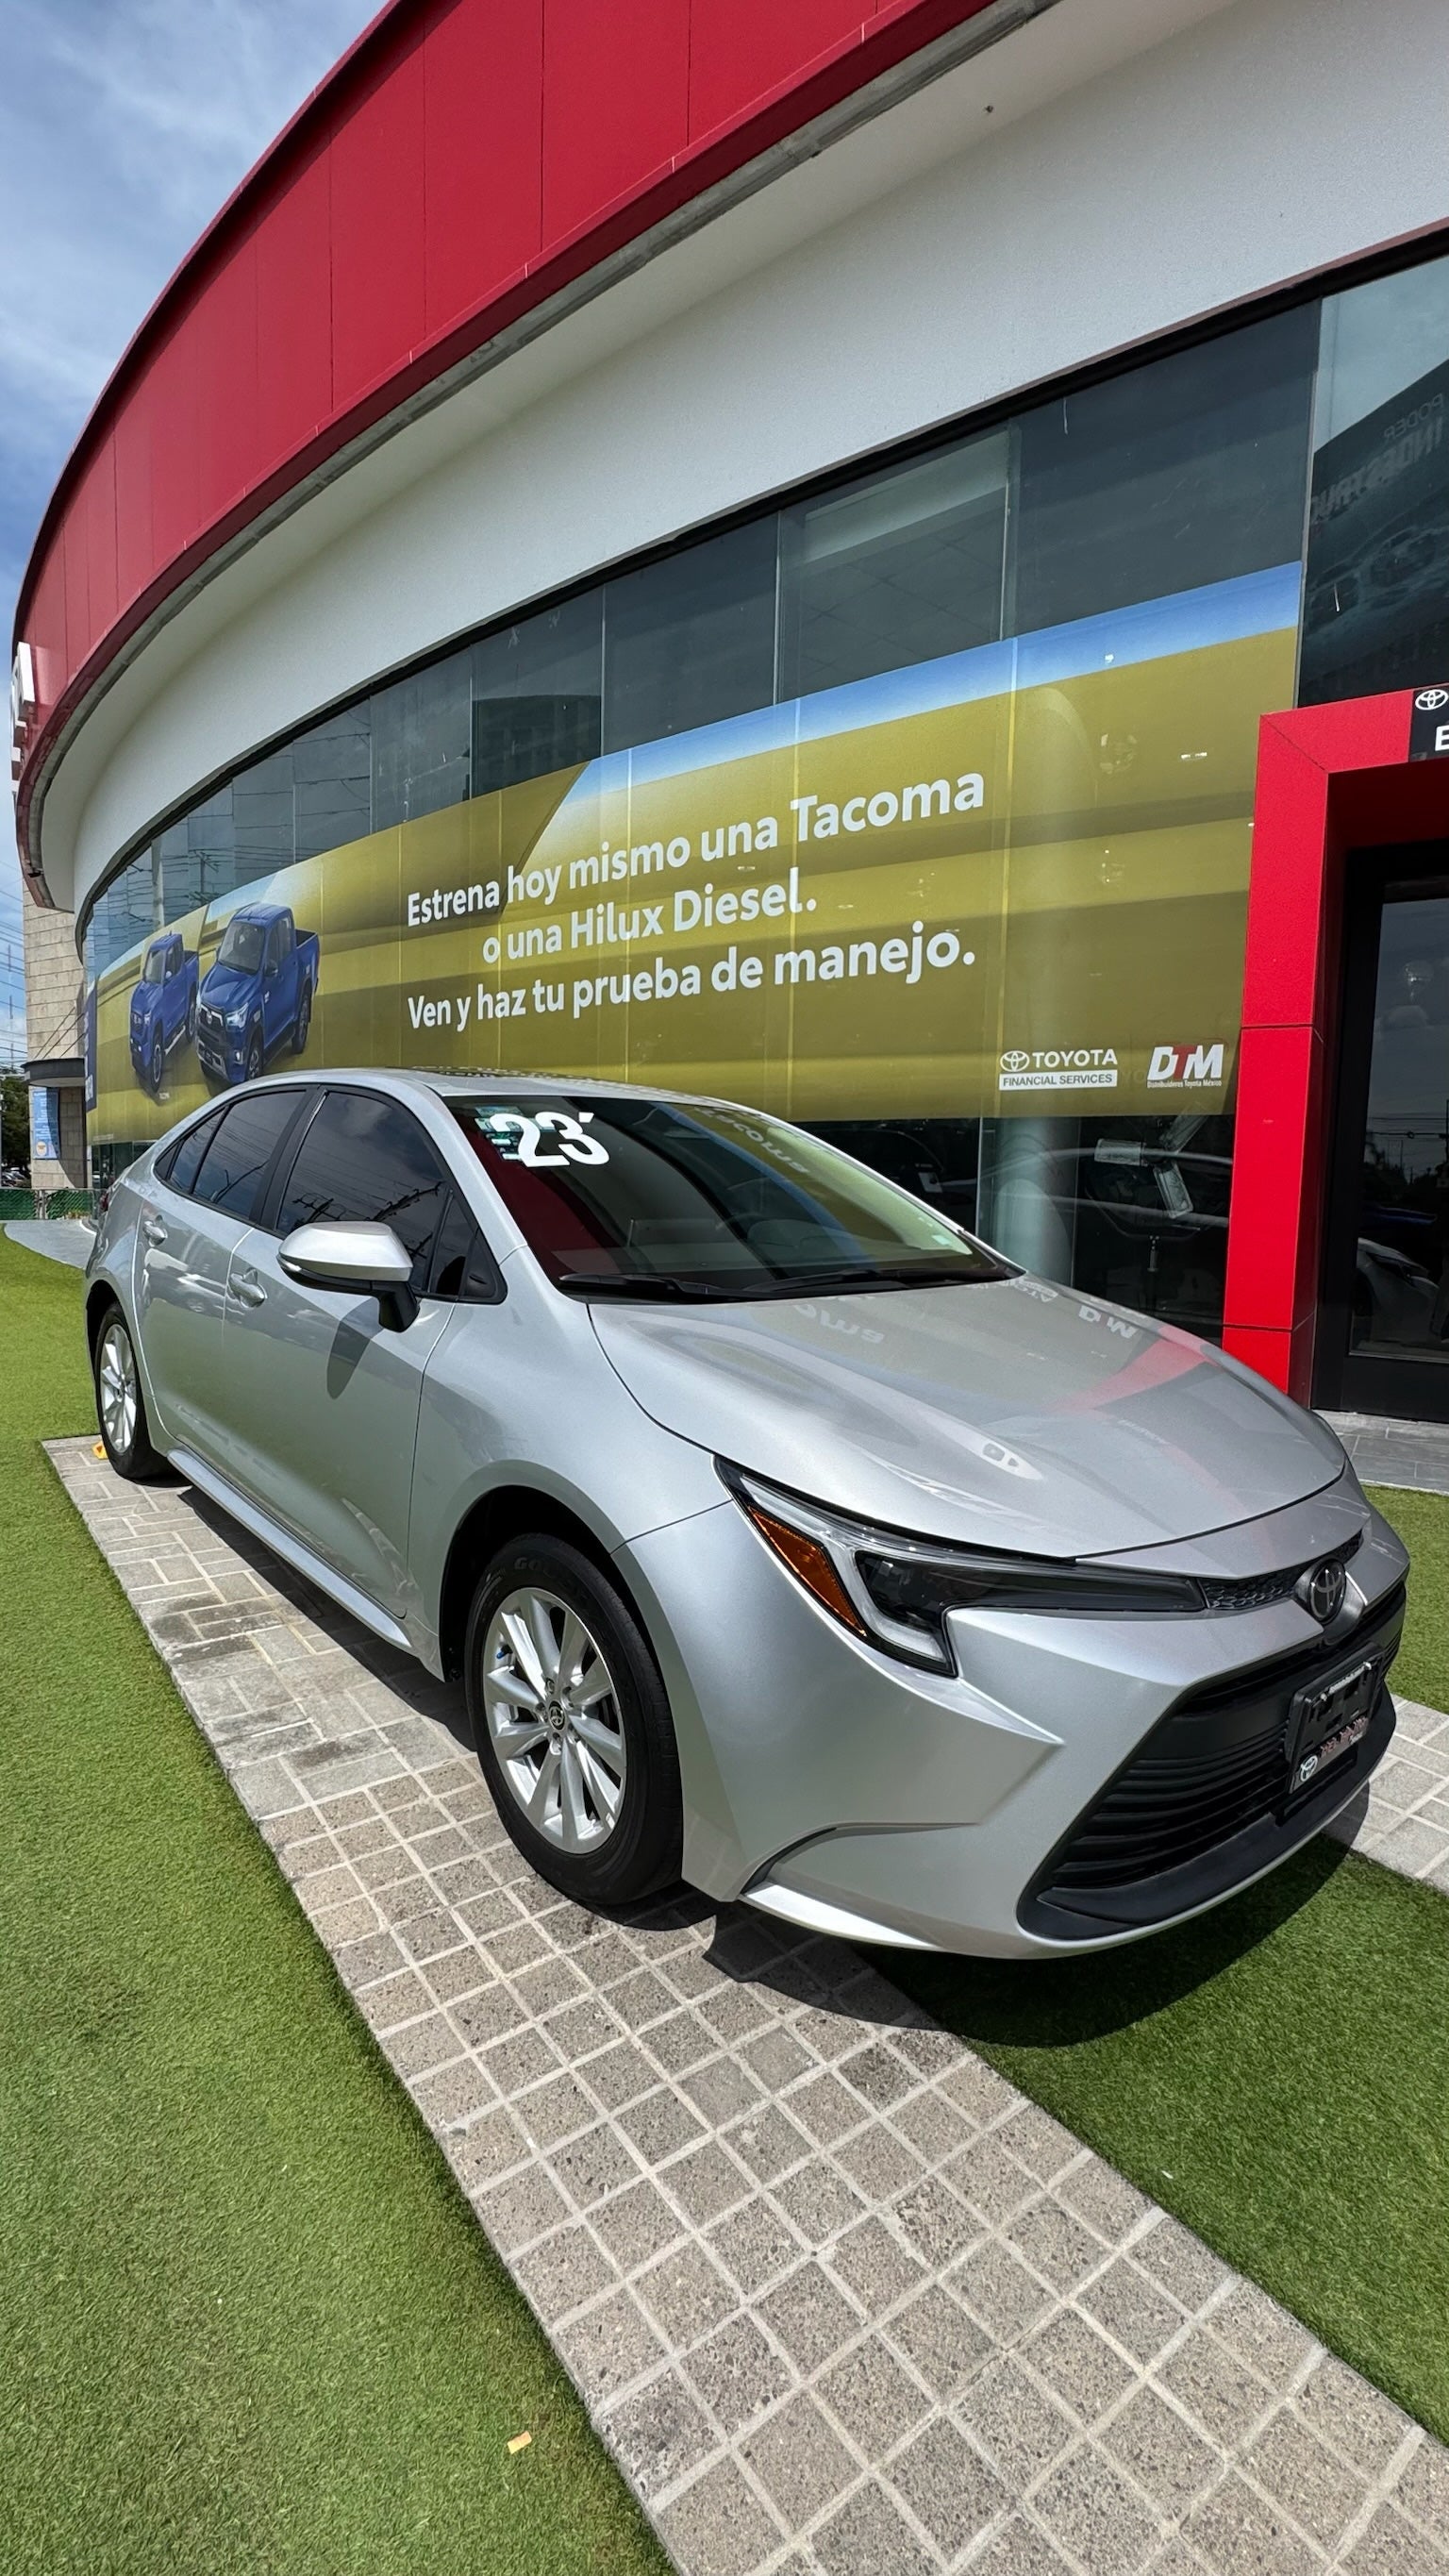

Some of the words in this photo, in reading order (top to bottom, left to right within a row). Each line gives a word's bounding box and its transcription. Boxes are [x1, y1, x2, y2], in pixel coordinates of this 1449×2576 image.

[408, 879, 500, 928] Estrena
[507, 865, 562, 906] hoy
[569, 841, 691, 890] mismo
[701, 816, 778, 861] una
[790, 773, 985, 842] Tacoma
[482, 936, 501, 963] o
[507, 924, 562, 960] una
[571, 901, 664, 949] Hilux
[674, 866, 817, 932] Diesel.
[408, 995, 451, 1029] Ven
[457, 995, 472, 1031] y
[477, 983, 526, 1020] haz
[532, 979, 565, 1013] tu
[573, 956, 702, 1019] prueba
[710, 945, 763, 992] de
[774, 920, 975, 985] manejo.
[1003, 1074, 1057, 1088] FINANCIAL
[1058, 1073, 1113, 1086] SERVICES
[1031, 1048, 1118, 1068] TOYOTA
[1146, 1044, 1224, 1080] DTM
